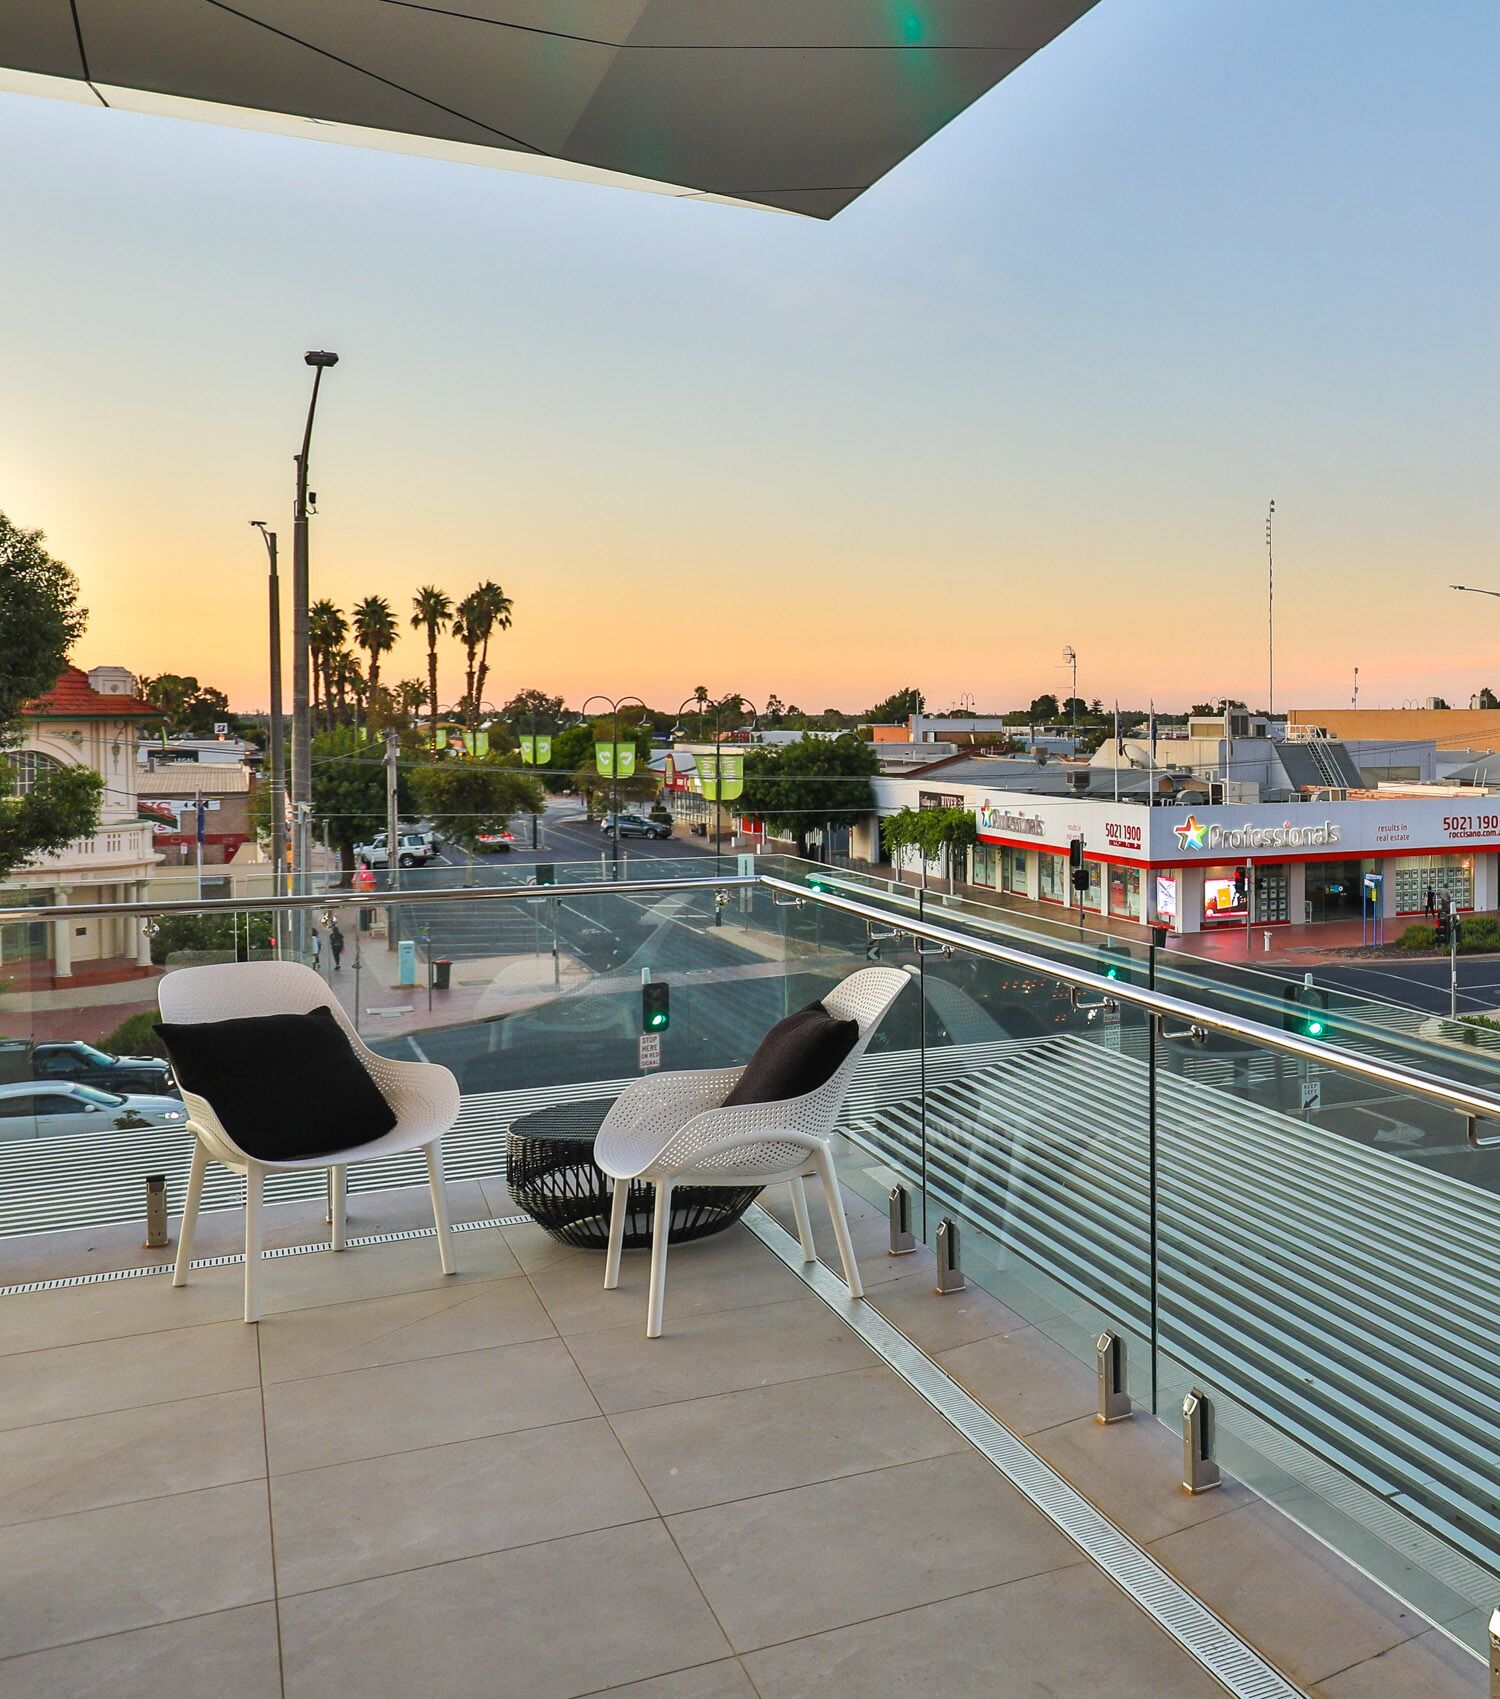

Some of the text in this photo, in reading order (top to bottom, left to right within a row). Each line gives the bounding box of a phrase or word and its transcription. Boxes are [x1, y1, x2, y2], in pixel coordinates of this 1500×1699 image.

[992, 808, 1046, 837] Professionals
[1443, 816, 1473, 831] 5021
[1105, 822, 1142, 842] 5021 1900
[1209, 820, 1341, 849] Professionals
[641, 1036, 658, 1044] STOP
[641, 1044, 658, 1052] HERE
[640, 1059, 659, 1067] SIGNAL
